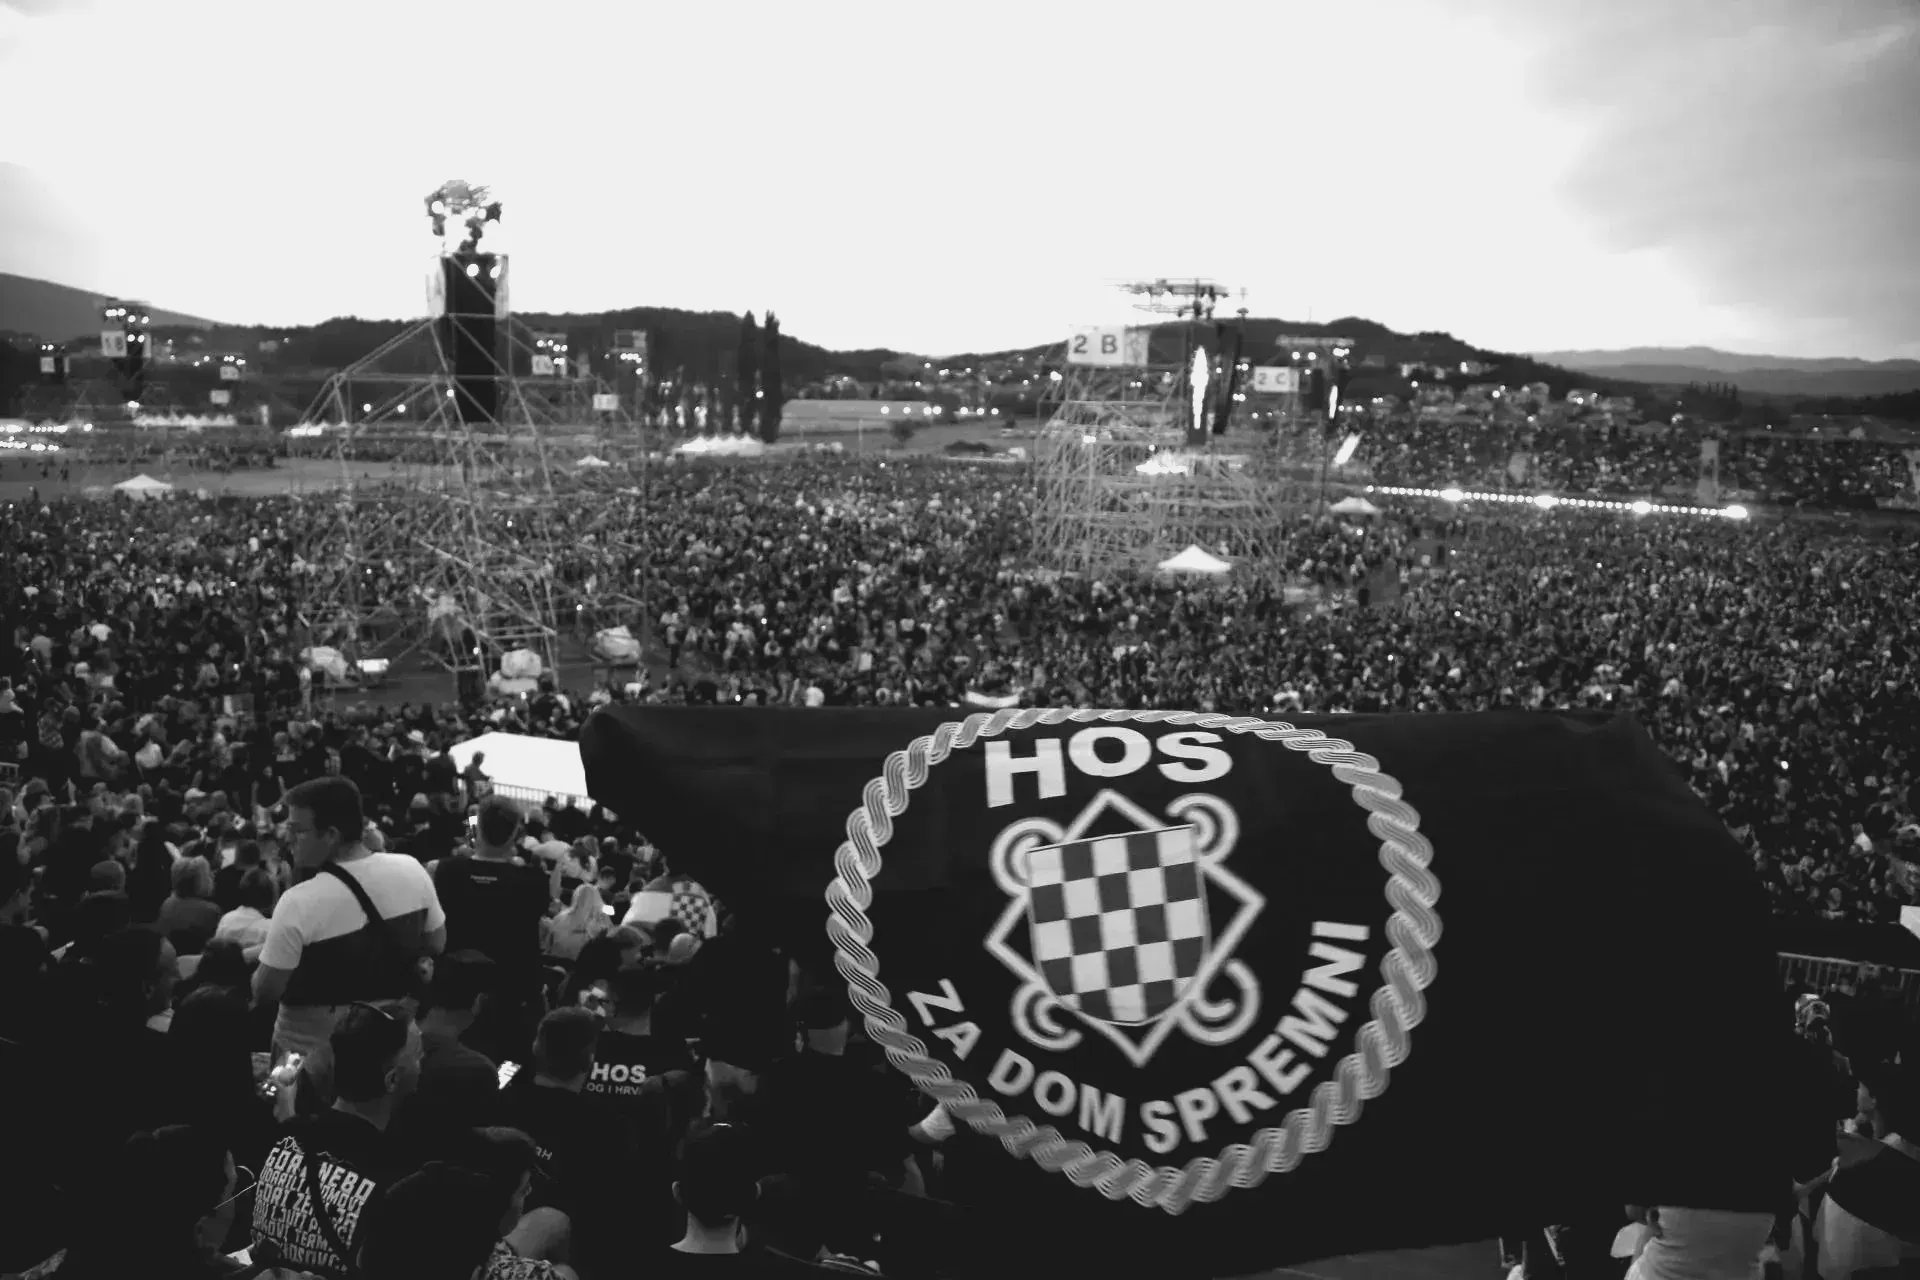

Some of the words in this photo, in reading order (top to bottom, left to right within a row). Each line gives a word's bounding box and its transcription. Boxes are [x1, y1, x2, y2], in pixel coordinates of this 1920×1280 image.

[1074, 334, 1088, 354] 2
[1101, 334, 1117, 354] B
[1258, 373, 1267, 385] 2
[1275, 373, 1286, 385] C
[986, 728, 1233, 808] HOS
[906, 978, 982, 1061] ZA
[987, 1049, 1126, 1144] DOM
[1140, 920, 1371, 1155] SPREMNI
[591, 1062, 646, 1084] HOS
[586, 1082, 604, 1093] OG
[615, 1085, 640, 1096] HRV
[256, 1180, 291, 1207] GORI
[318, 1161, 377, 1203] NEBO
